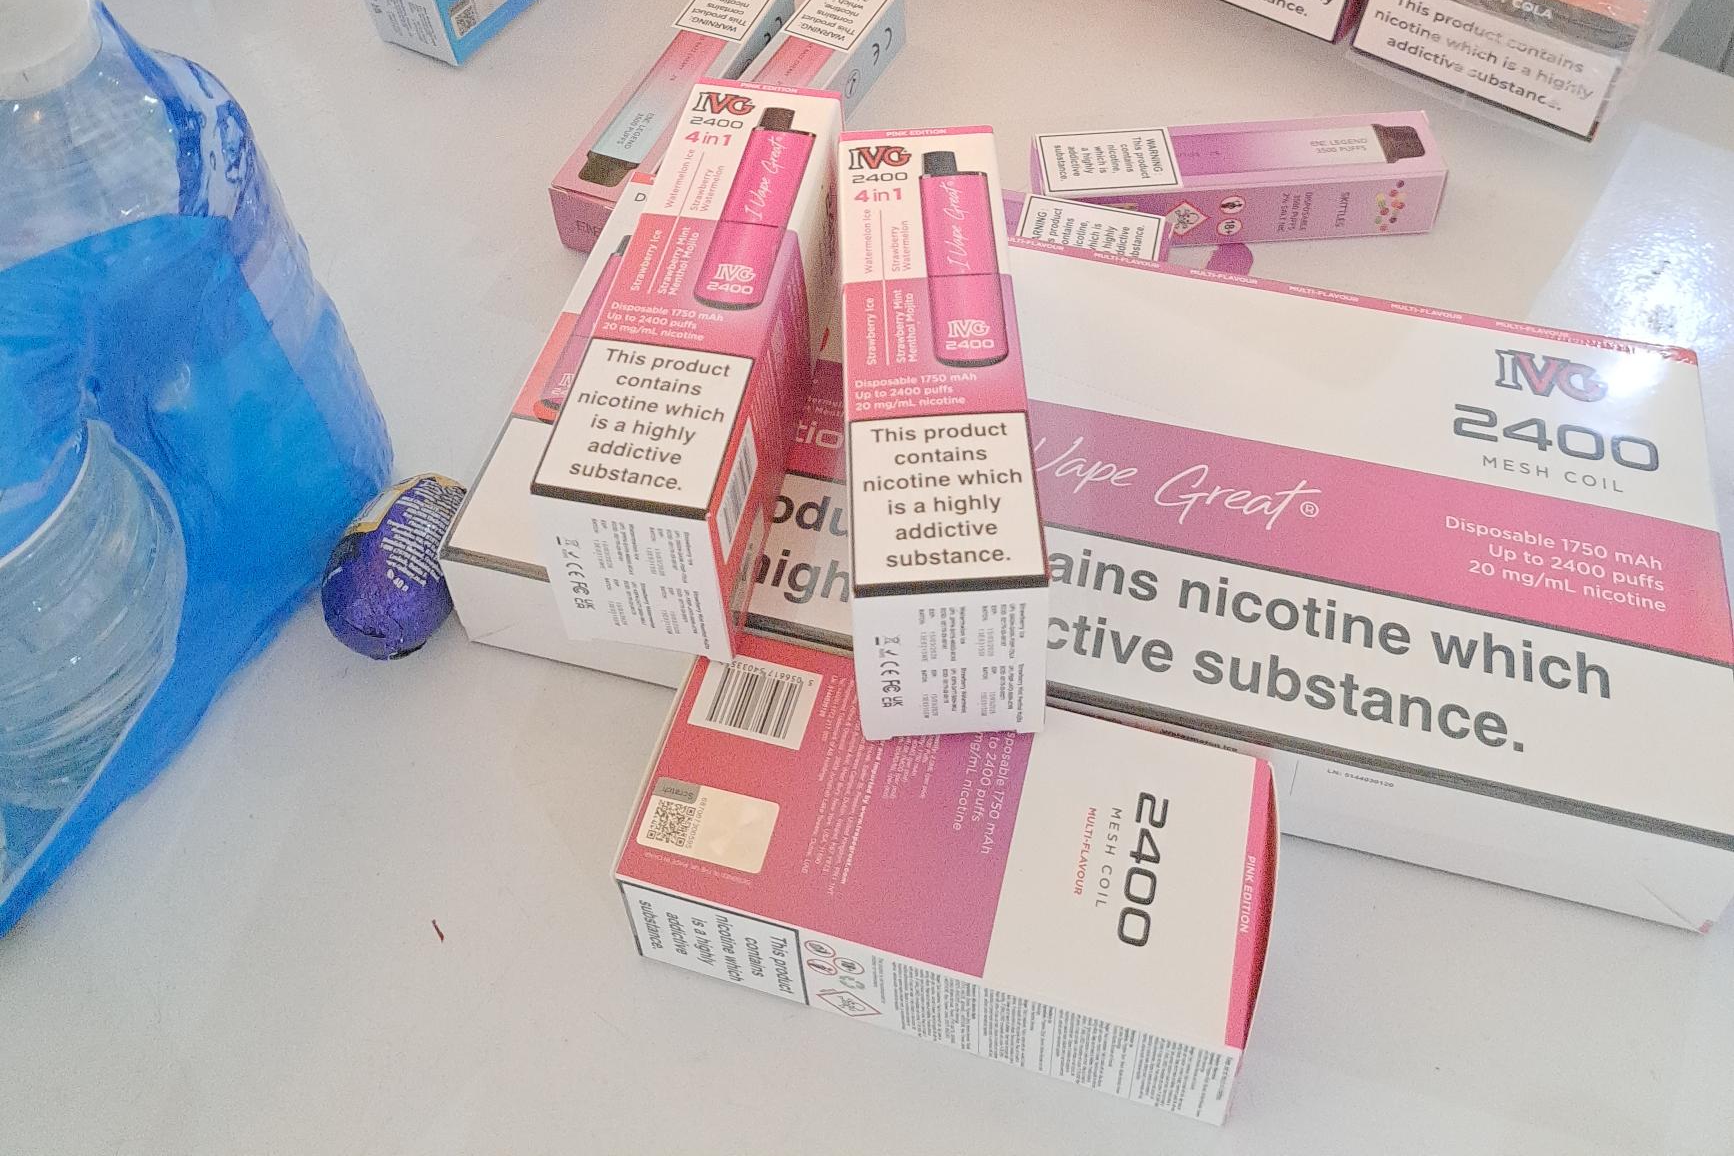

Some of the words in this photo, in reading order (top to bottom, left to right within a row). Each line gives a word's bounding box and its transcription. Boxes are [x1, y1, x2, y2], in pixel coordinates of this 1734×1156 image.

[692, 91, 755, 116] IVG
[689, 116, 744, 130] 2400
[909, 128, 947, 136] EDITION
[685, 131, 700, 143] 4
[702, 131, 720, 146] in
[723, 133, 732, 147] 1
[1132, 137, 1142, 153] This
[848, 146, 912, 170] IVG
[1054, 145, 1068, 181] substance.
[1068, 146, 1080, 177] addictive
[1082, 153, 1095, 174] highly
[1094, 146, 1106, 167] which
[1120, 144, 1134, 173] contains
[1134, 151, 1150, 179] product
[852, 172, 908, 184] 2400
[854, 189, 869, 203] 4
[873, 189, 890, 202] in
[892, 188, 903, 201] 1
[864, 223, 873, 274] Watermelon
[606, 348, 646, 366] This
[651, 356, 731, 377] product
[1494, 349, 1609, 403] IVG
[616, 374, 703, 395] contains
[578, 391, 659, 413] nicotine
[665, 403, 726, 423] which
[591, 414, 608, 429] is
[614, 422, 625, 432] a
[632, 420, 697, 445] highly
[871, 428, 917, 444] This
[924, 422, 1008, 444] product
[1453, 404, 1659, 472] 2400
[588, 440, 682, 465] addictive
[894, 446, 988, 466] contains
[569, 462, 682, 491] substance.
[863, 472, 951, 493] nicotine
[957, 468, 1023, 486] which
[1482, 455, 1550, 478] MESH
[1564, 471, 1624, 493] COIL
[887, 499, 907, 516] is
[914, 502, 925, 514] a
[933, 494, 1001, 516] highly
[1154, 464, 1322, 530] Great
[895, 521, 999, 541] addictive
[1445, 515, 1555, 548] Disposable
[1560, 538, 1608, 558] 1750
[1614, 550, 1663, 571] mAh
[886, 547, 1011, 569] substance.
[1488, 544, 1517, 562] Up
[1523, 550, 1544, 566] to
[1551, 556, 1606, 578] 2400
[1613, 571, 1665, 592] puffs
[1468, 560, 1496, 576] 20
[1501, 567, 1576, 592] mg/mL
[1583, 584, 1667, 612] nicotine
[1048, 548, 1158, 602] ains
[1178, 577, 1411, 655] nicotine
[1431, 630, 1611, 699] which
[1046, 614, 1174, 673] ctive
[1192, 648, 1525, 753] substance.
[1102, 806, 1123, 857] MESH
[1072, 806, 1097, 897] MULTI-FLAVOUR
[1117, 791, 1170, 947] 2400
[1245, 855, 1257, 892] PINK
[1094, 864, 1113, 909] COIL
[1239, 894, 1254, 934] EDITION
